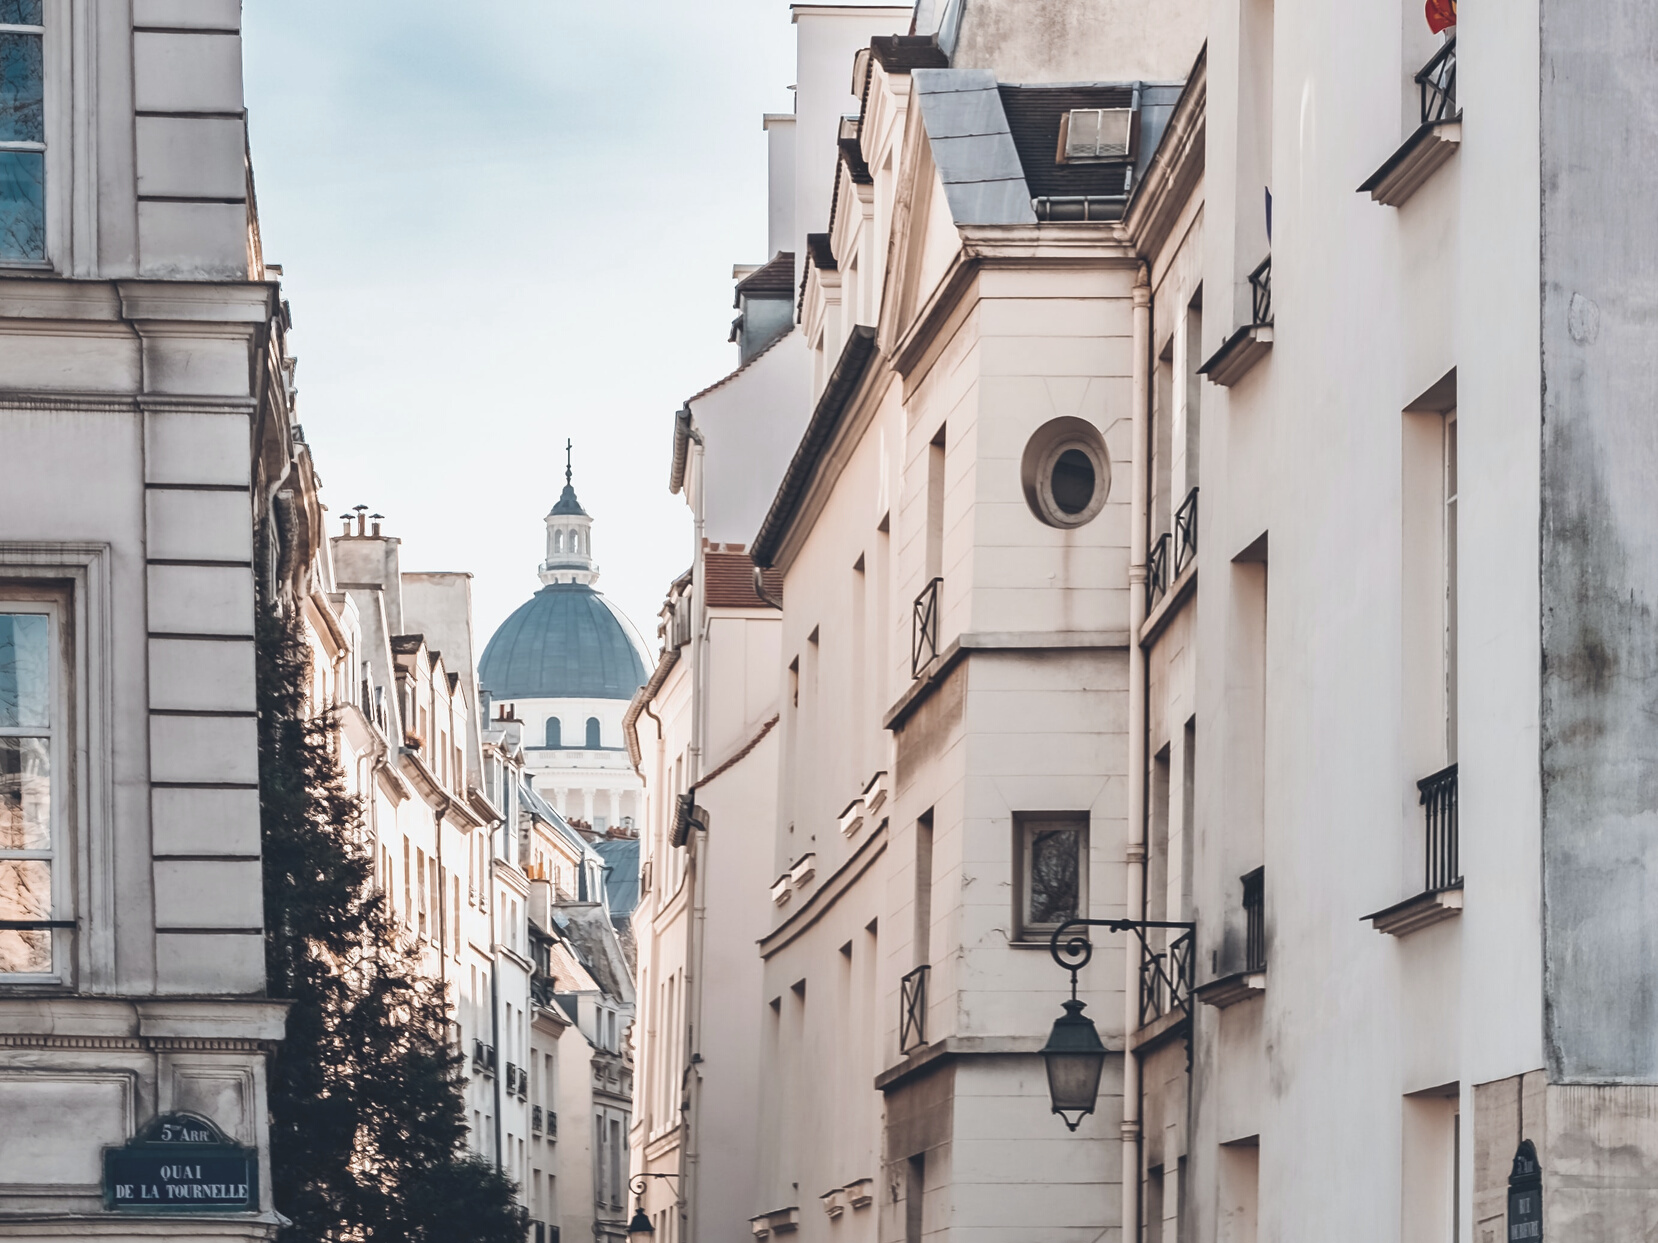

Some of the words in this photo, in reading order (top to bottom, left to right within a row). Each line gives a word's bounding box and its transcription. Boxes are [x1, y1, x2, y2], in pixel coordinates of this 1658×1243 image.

[160, 1165, 202, 1181] QUAI
[115, 1184, 134, 1199] DE
[141, 1184, 160, 1199] LA
[166, 1184, 248, 1199] TOURNELLE
